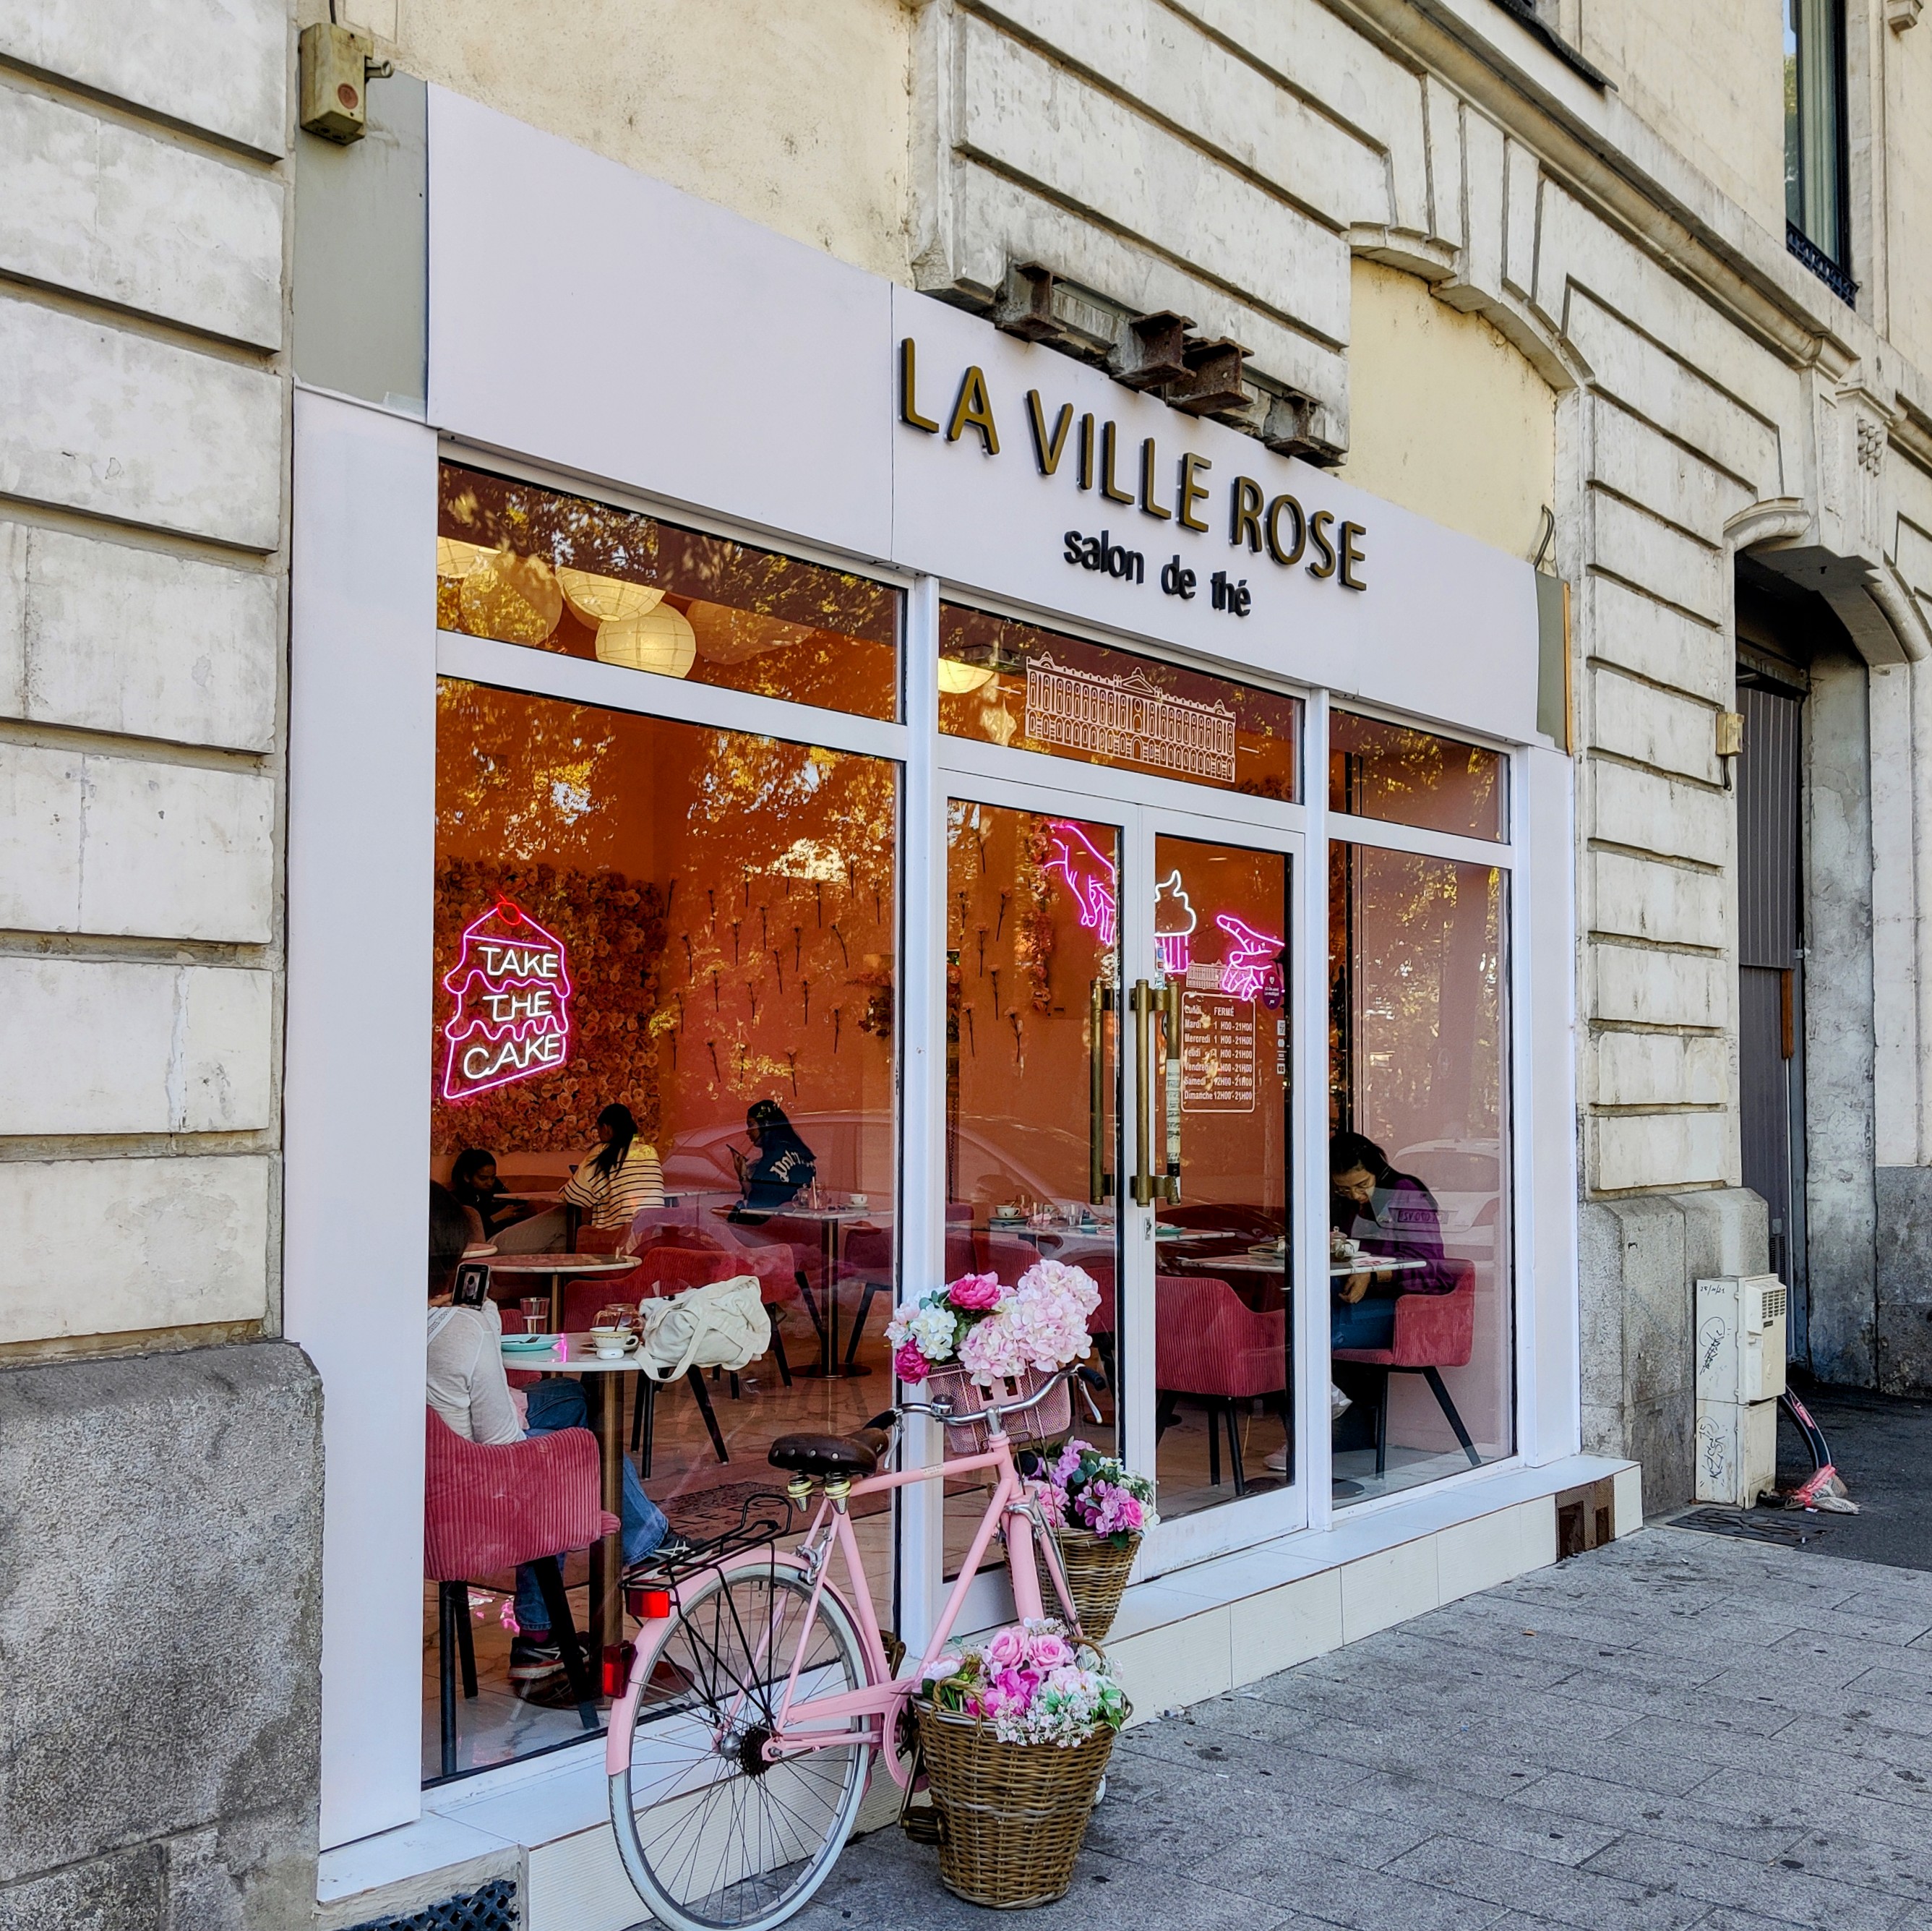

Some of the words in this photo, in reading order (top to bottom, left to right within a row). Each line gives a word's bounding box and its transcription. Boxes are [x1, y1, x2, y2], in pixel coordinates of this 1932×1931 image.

[900, 337, 1000, 455] LA
[1026, 389, 1212, 533] VILLE
[1231, 476, 1367, 591] ROSE
[1063, 530, 1144, 584] salon
[1162, 555, 1196, 600] de
[1211, 570, 1251, 617] thé
[478, 946, 558, 977] TAKE
[482, 990, 551, 1022] THE
[1214, 1006, 1235, 1016] FERMÉ
[1185, 1019, 1201, 1029] Mardi
[1185, 1033, 1211, 1043] Mercredi
[463, 1033, 560, 1079] CAKE
[1184, 1076, 1206, 1086] Samedi
[1185, 1090, 1213, 1100] Dimanche
